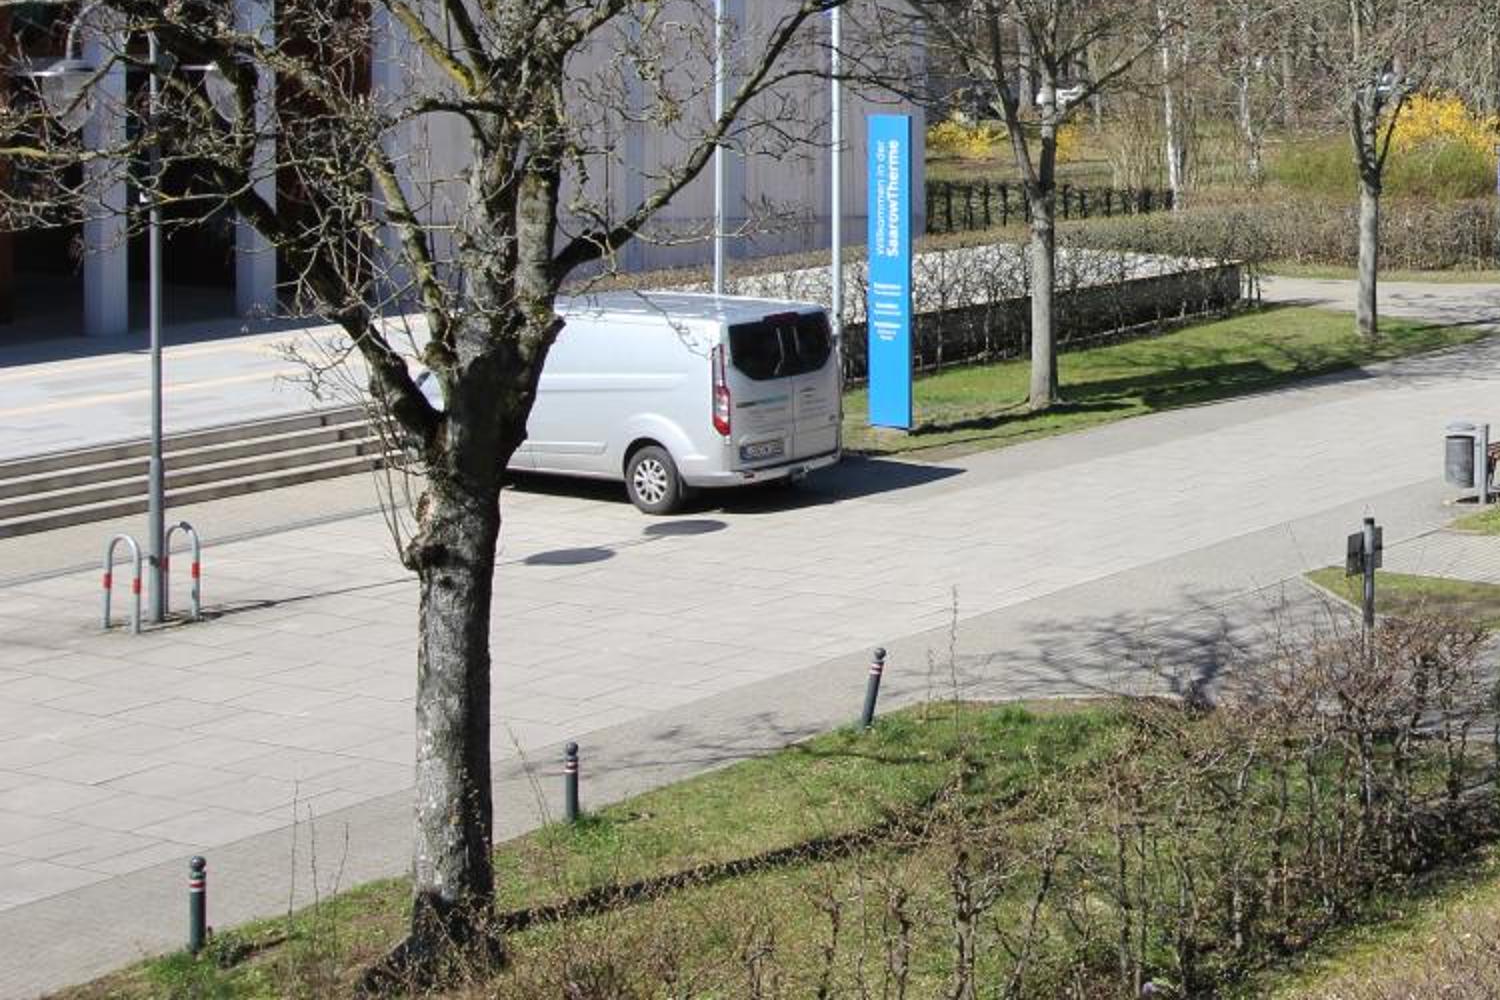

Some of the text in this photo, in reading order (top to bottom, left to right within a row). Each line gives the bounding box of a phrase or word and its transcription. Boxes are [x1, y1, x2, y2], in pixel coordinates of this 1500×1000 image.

[875, 140, 886, 256] Willkommen in der
[886, 139, 899, 257] SaarowTherme
